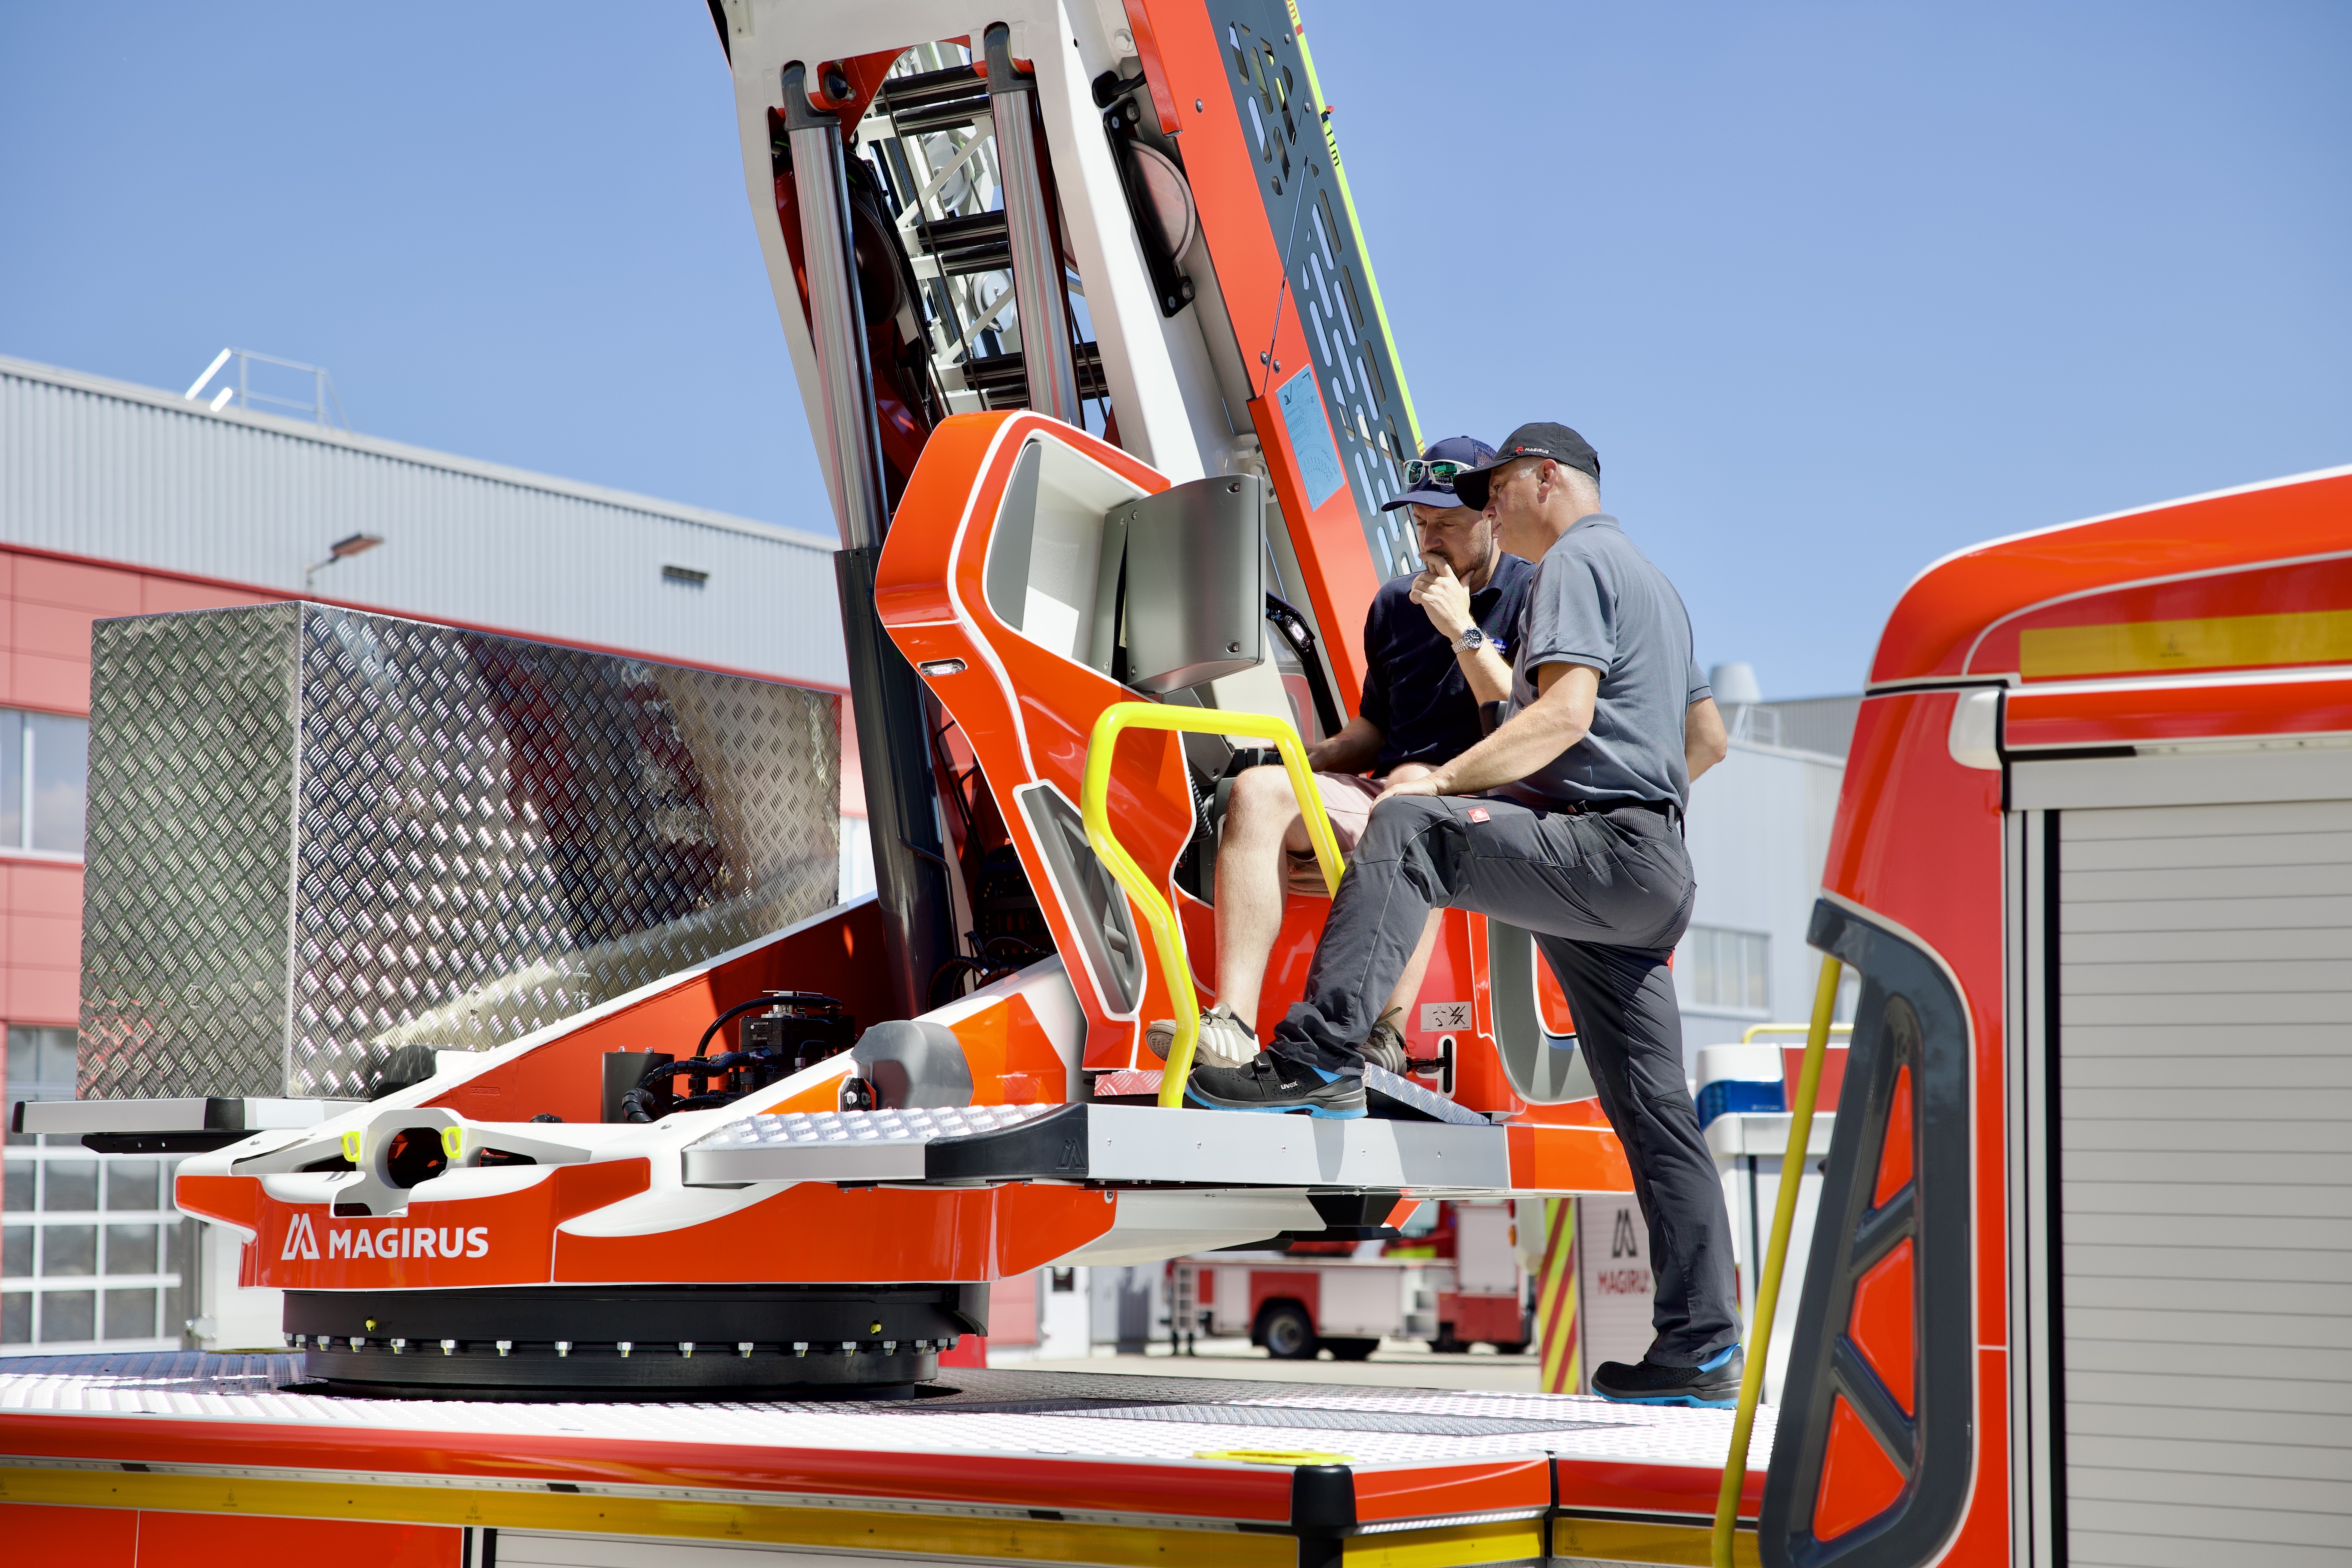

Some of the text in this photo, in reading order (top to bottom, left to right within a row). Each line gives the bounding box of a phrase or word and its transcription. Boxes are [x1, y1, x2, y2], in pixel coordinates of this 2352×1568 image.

[1326, 128, 1340, 166] 11m
[1416, 438, 1426, 459] 18
[1280, 1081, 1298, 1090] uvex
[329, 1227, 489, 1259] MAGIRUS
[1598, 1270, 1651, 1295] MAGIRU
